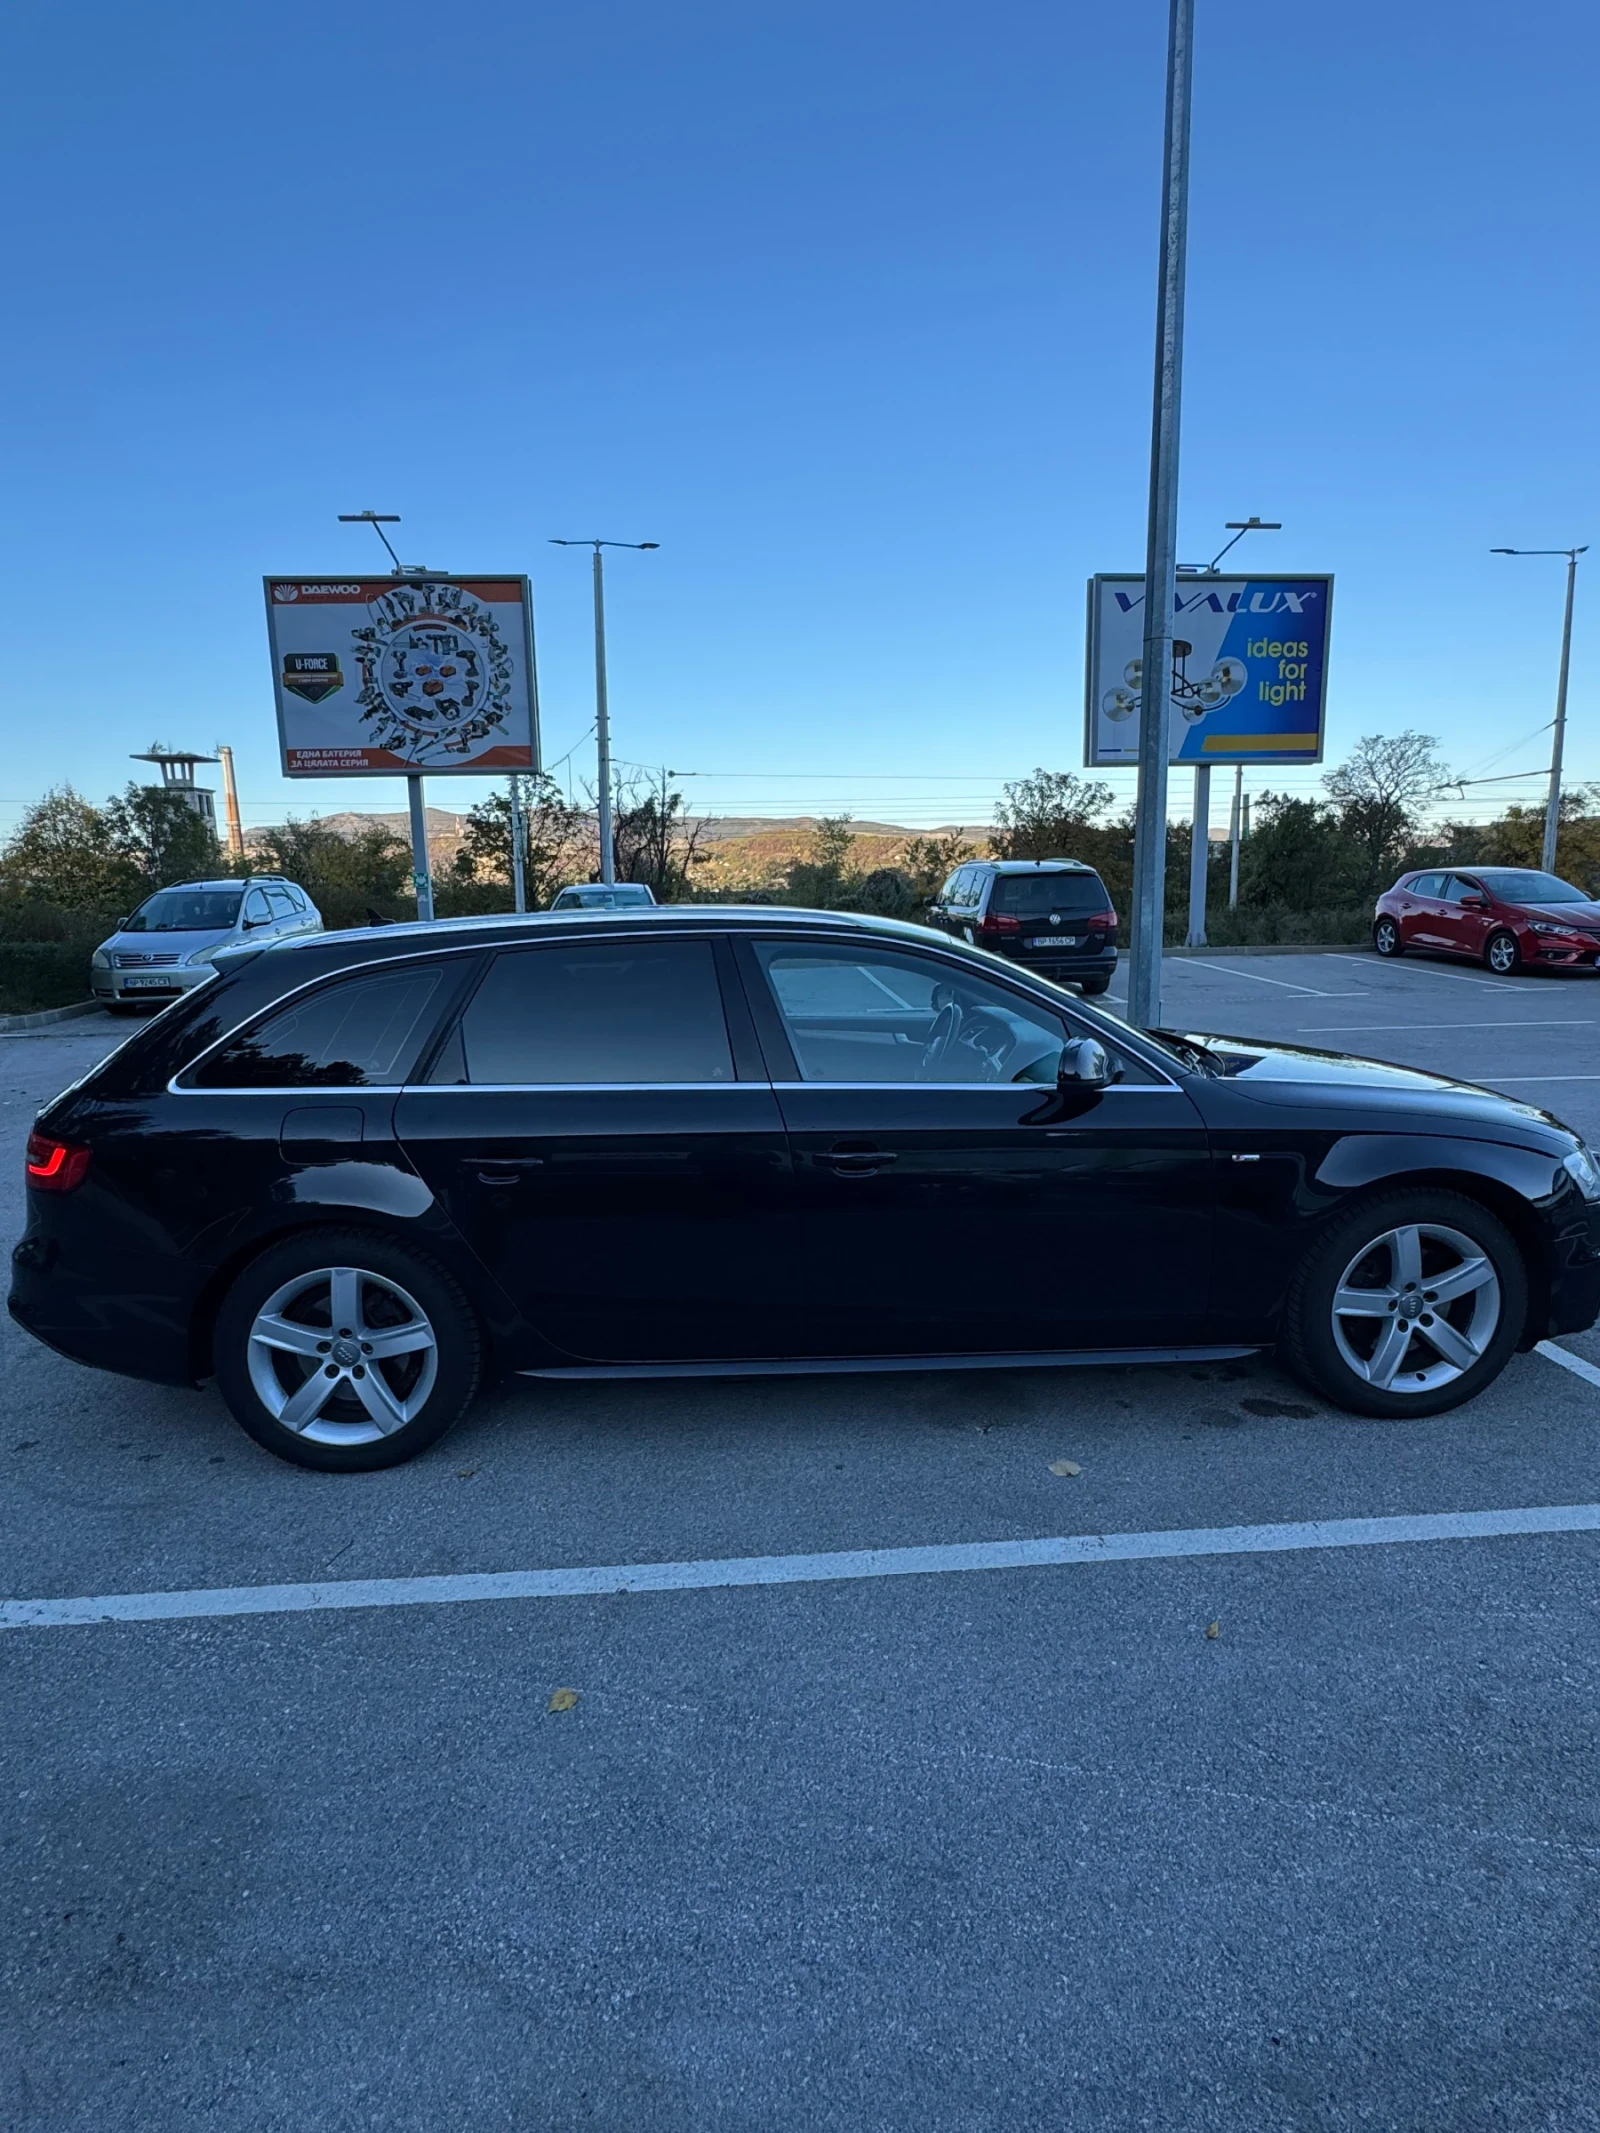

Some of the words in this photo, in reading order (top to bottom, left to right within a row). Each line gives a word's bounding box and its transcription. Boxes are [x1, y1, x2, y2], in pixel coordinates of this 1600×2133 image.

[301, 584, 361, 594] DAEWOO
[1114, 592, 1312, 613] VVALUX
[1247, 637, 1309, 658] ideas
[295, 658, 328, 670] U-FORCE
[1278, 659, 1308, 680] for
[1259, 681, 1306, 707] light
[296, 750, 320, 759] ЕДНА
[322, 750, 362, 758] БАТЕРИЯ
[291, 760, 302, 768] ЗА
[304, 759, 339, 768] ЦЯЛАТА
[340, 759, 369, 767] СЕРИЯ
